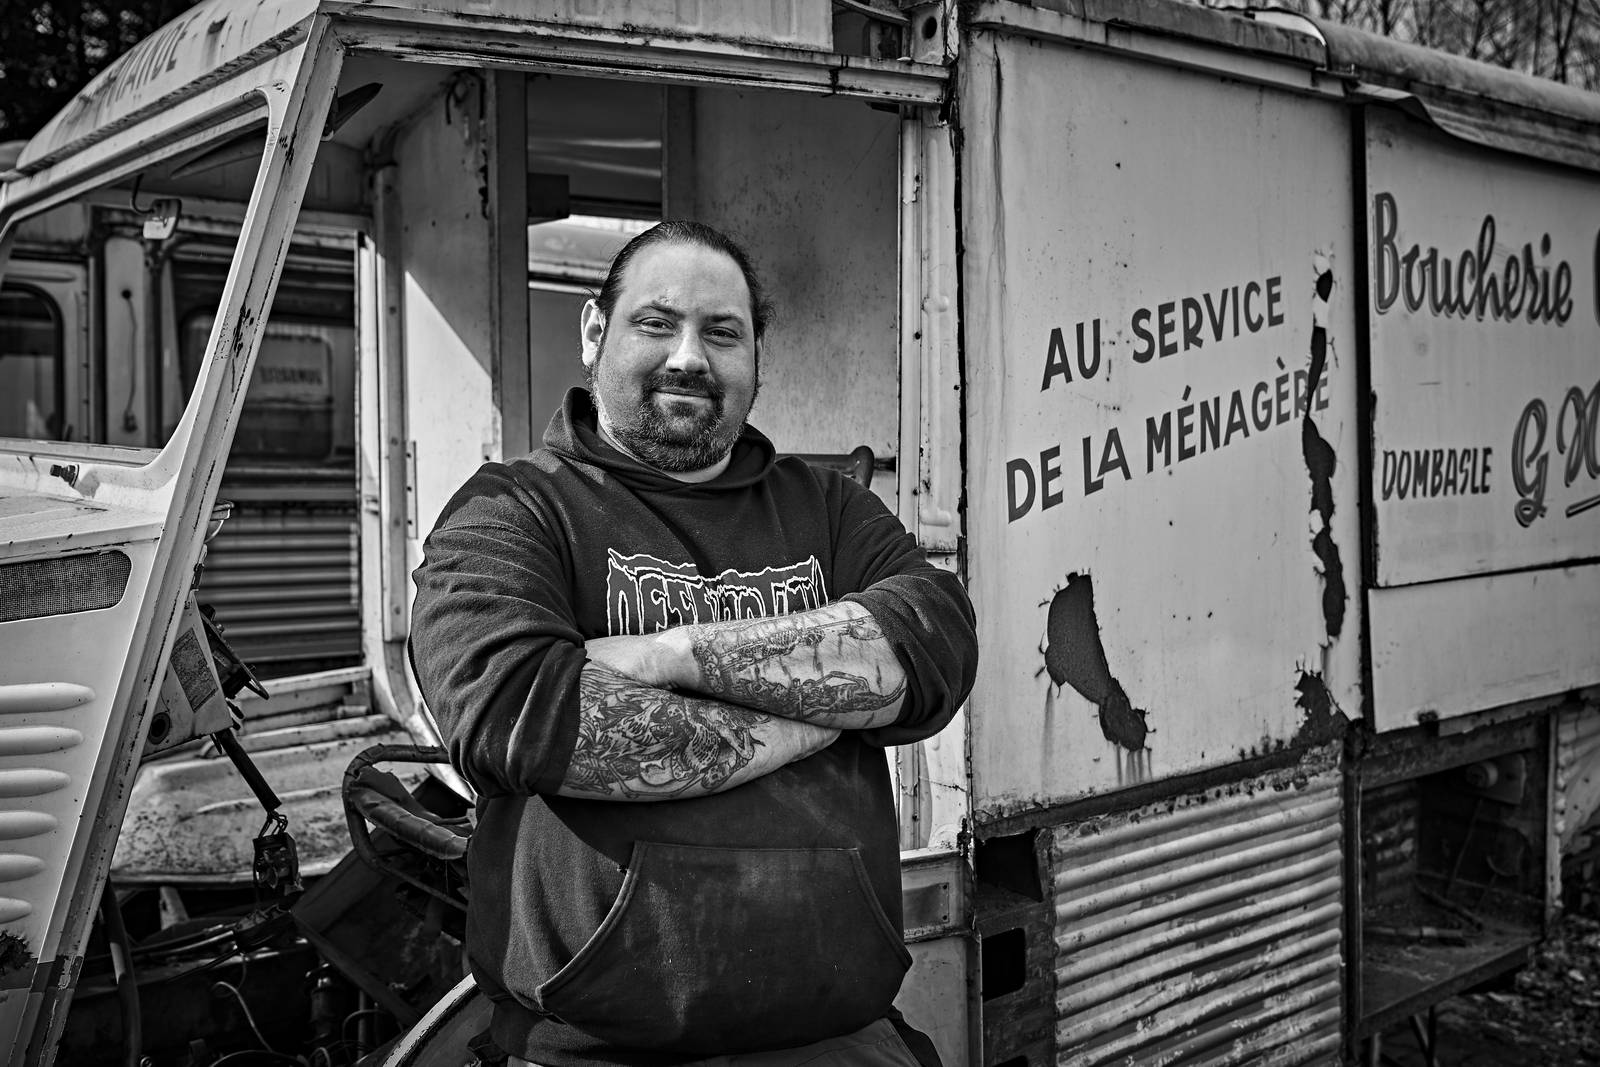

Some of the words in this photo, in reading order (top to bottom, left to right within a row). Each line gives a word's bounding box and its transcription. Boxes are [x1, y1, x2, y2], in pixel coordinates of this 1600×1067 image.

[1375, 192, 1573, 327] Boucherie
[1041, 319, 1101, 392] AU
[1131, 276, 1284, 364] SERVICE
[1006, 445, 1064, 524] DE
[1082, 427, 1132, 496] LA
[1146, 357, 1329, 474] MÉNAGÈRE
[1382, 447, 1493, 501] DOMBASLE
